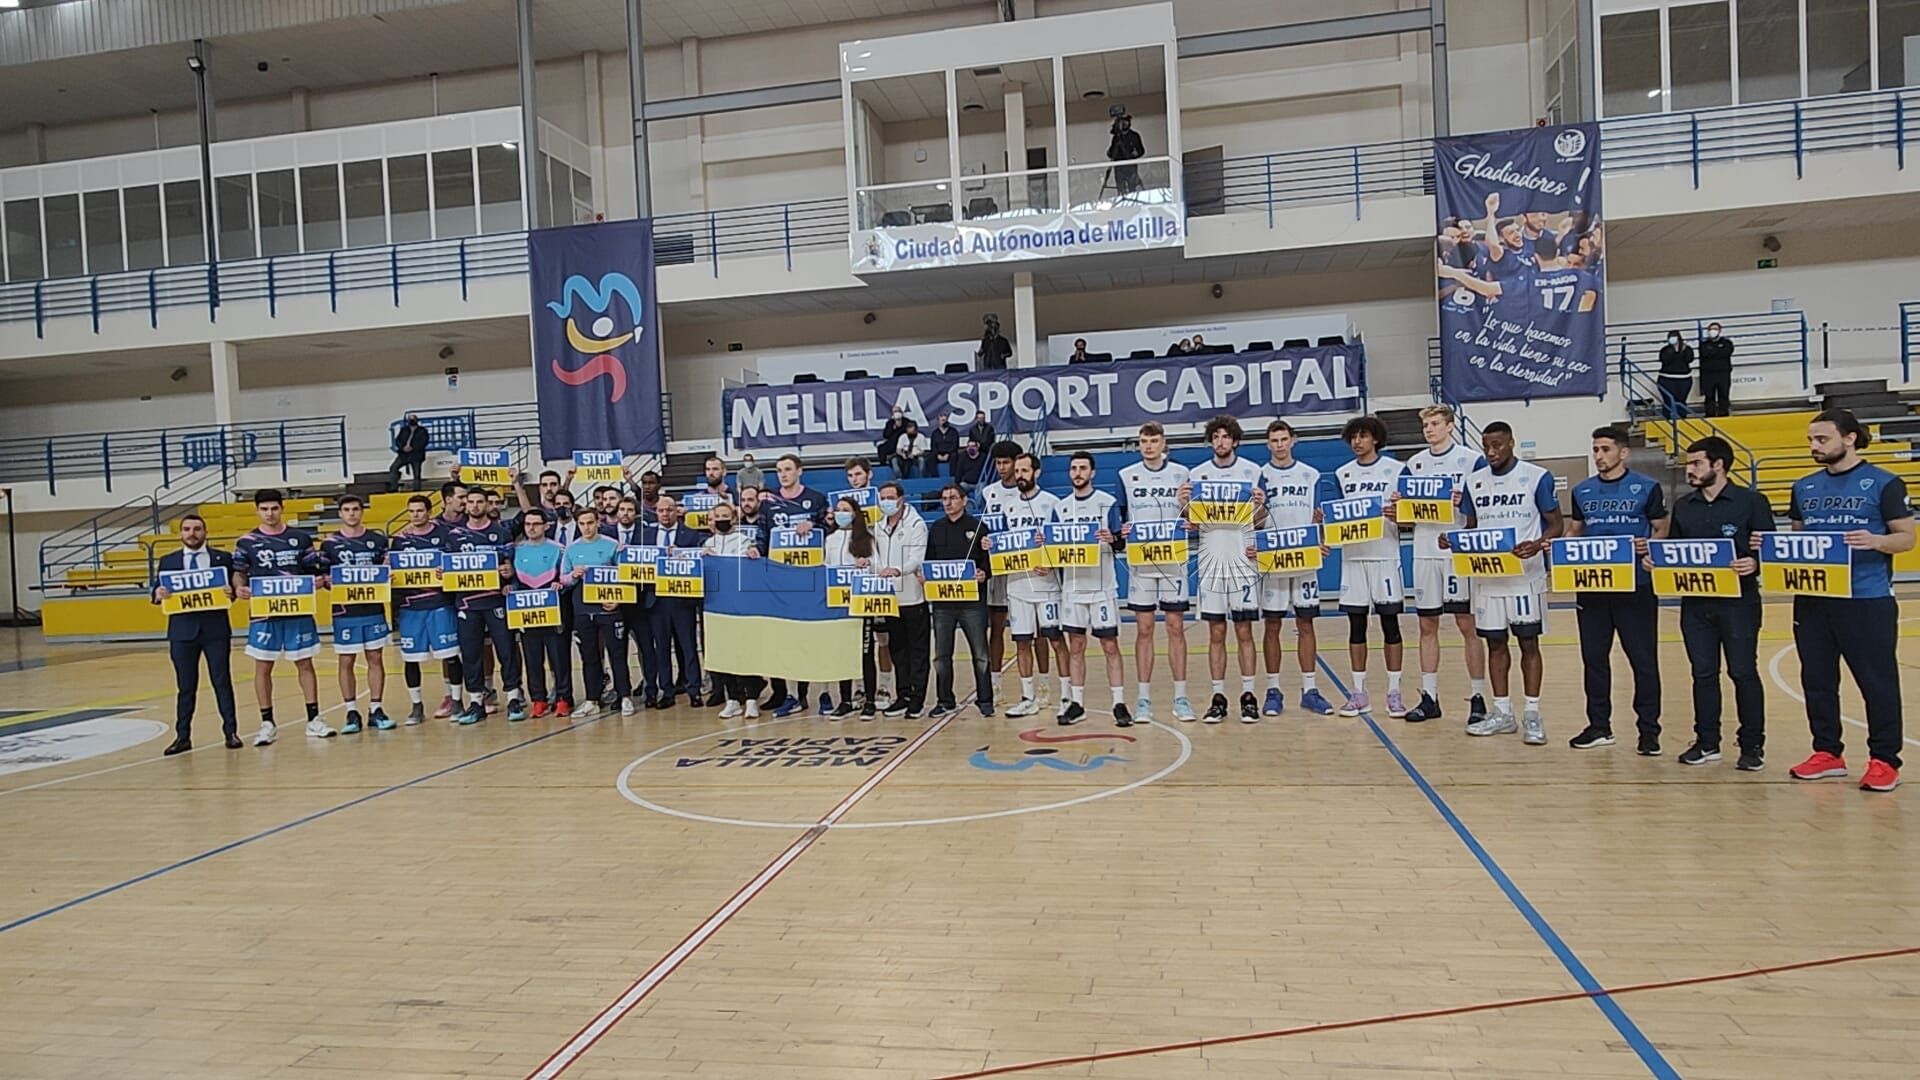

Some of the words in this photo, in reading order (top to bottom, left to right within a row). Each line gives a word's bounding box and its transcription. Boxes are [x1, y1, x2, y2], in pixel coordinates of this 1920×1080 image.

[1455, 153, 1568, 196] Gladiadores
[895, 236, 964, 260] Ciudad
[971, 227, 1075, 254] Autónoma
[1079, 225, 1105, 244] de
[1107, 215, 1178, 242] Melilla
[1541, 285, 1575, 310] 17
[1501, 322, 1523, 340] que
[1524, 321, 1572, 348] hacemos
[1454, 330, 1473, 343] en
[1475, 328, 1490, 347] la
[1492, 338, 1517, 354] vida
[1519, 343, 1552, 364] tiene
[1551, 356, 1566, 368] su
[1567, 362, 1592, 374] eco
[1469, 355, 1487, 368] en
[1489, 352, 1505, 372] la
[732, 386, 929, 438] MELILLA
[947, 373, 1118, 426] SPORT
[1134, 355, 1359, 414] CAPITAL
[468, 452, 501, 465] STOP
[582, 452, 614, 465] STOP
[473, 469, 498, 482] WAR
[587, 468, 611, 481] WAR
[1132, 488, 1147, 498] CB
[1150, 487, 1178, 497] PRAT
[1200, 483, 1242, 500] STOP
[1281, 486, 1308, 496] PRAT
[1344, 483, 1356, 494] CB
[1360, 482, 1389, 492] PRAT
[1406, 479, 1444, 497] STOP
[1475, 495, 1490, 508] CB
[1492, 494, 1526, 506] PRAT
[1582, 500, 1598, 513] CB
[1601, 499, 1638, 511] PRAT
[1802, 498, 1819, 511] CB
[1822, 496, 1867, 511] PRAT
[1206, 507, 1236, 521] WAR
[1333, 501, 1372, 520] STOP
[1412, 503, 1439, 520] WAR
[1052, 526, 1090, 542] STOP
[1135, 523, 1175, 540] STOP
[1266, 529, 1308, 548] STOP
[1340, 524, 1369, 541] WAR
[997, 532, 1032, 550] STOP
[1459, 531, 1504, 552] STOP
[1775, 536, 1833, 559] STOP
[627, 549, 659, 562] STOP
[783, 551, 810, 565] WAR
[1058, 549, 1086, 563] WAR
[1142, 547, 1172, 561] WAR
[1566, 540, 1618, 561] STOP
[1662, 543, 1718, 564] STOP
[399, 552, 434, 567] STOP
[451, 555, 488, 570] STOP
[664, 560, 695, 575] STOP
[1003, 554, 1029, 570] WAR
[1274, 552, 1305, 568] WAR
[1469, 556, 1504, 573] WAR
[341, 567, 381, 583] STOP
[405, 572, 431, 585] WAR
[594, 570, 619, 582] STO
[630, 567, 655, 580] WAR
[932, 563, 966, 579] STOP
[1574, 569, 1613, 588] WAR
[170, 571, 215, 591] STOP
[262, 579, 303, 594] STOP
[457, 574, 484, 588] WAR
[668, 580, 691, 593] WAR
[1448, 576, 1457, 594] 5
[1673, 572, 1716, 592] WAR
[1784, 568, 1827, 591] WAR
[347, 586, 376, 601] WAR
[597, 587, 623, 600] WAR
[938, 584, 965, 599] WAR
[1175, 580, 1182, 596] 7
[1242, 585, 1250, 602] 2
[1302, 581, 1319, 600] 32
[1385, 579, 1392, 597] 1
[180, 592, 214, 609] WAR
[268, 599, 300, 614] WAR
[516, 592, 549, 606] STOP
[864, 599, 891, 613] WAR
[1516, 595, 1530, 616] 11
[522, 611, 547, 625] WAR
[1046, 604, 1058, 620] 31
[1101, 606, 1108, 622] 3
[256, 632, 272, 645] 77
[341, 629, 350, 640] 6
[717, 736, 908, 747] CAPITAL
[724, 746, 897, 756] SPORT
[676, 756, 884, 767] MELILLA
